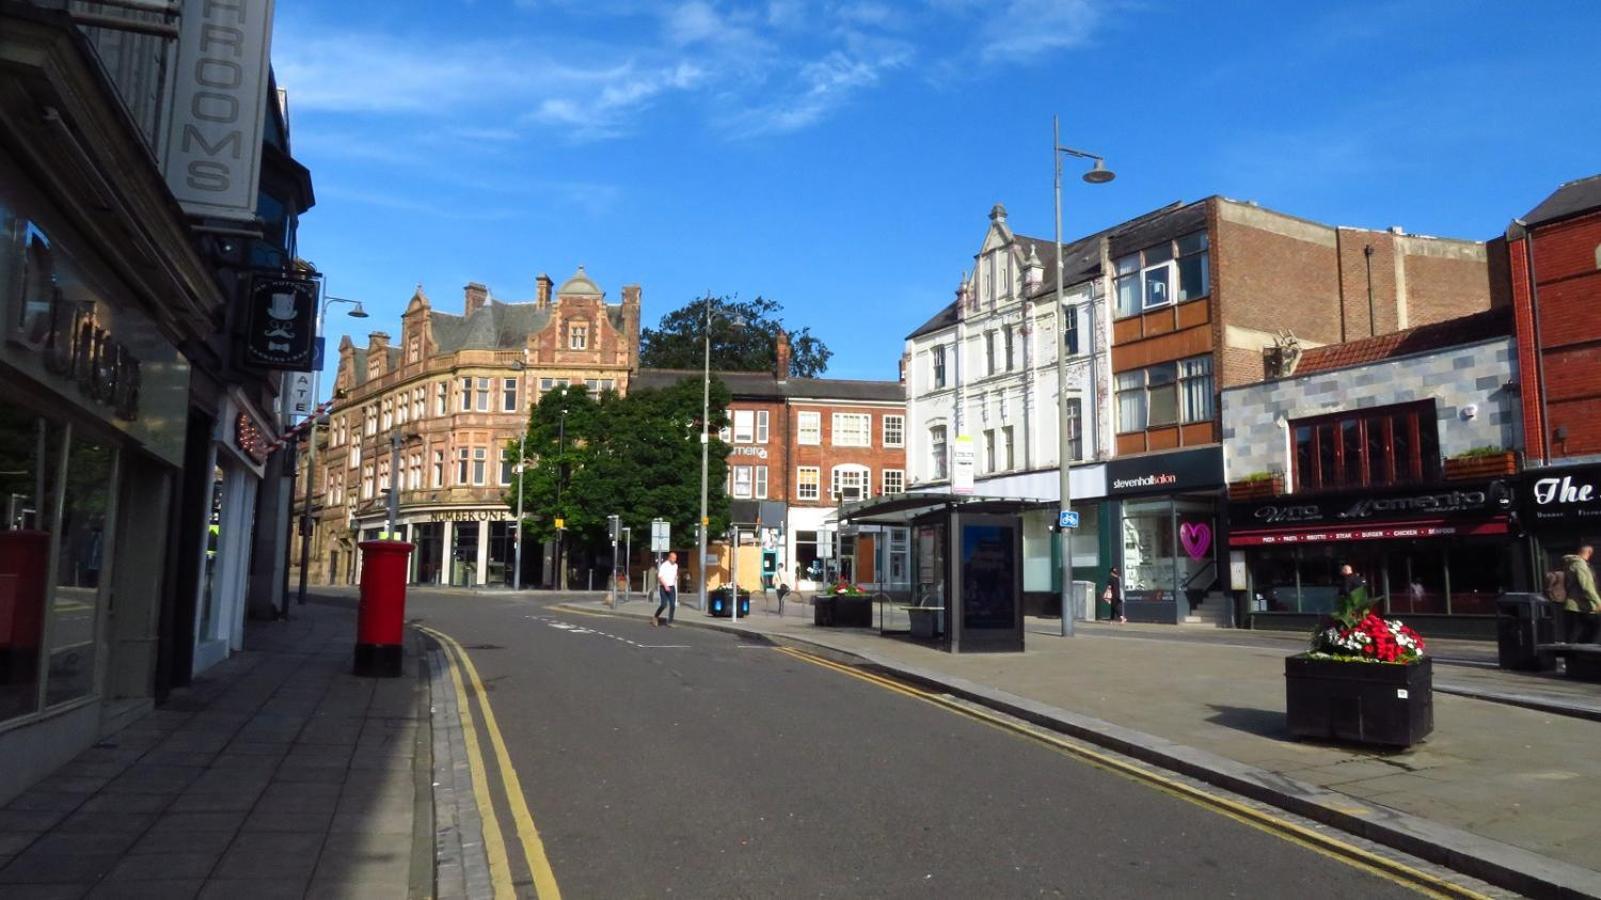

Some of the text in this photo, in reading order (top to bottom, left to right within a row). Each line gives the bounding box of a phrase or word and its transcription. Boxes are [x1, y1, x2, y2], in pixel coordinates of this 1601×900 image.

[1534, 475, 1595, 505] The
[430, 511, 507, 522] NUMBER ONE
[1393, 529, 1418, 537] CHICKEN
